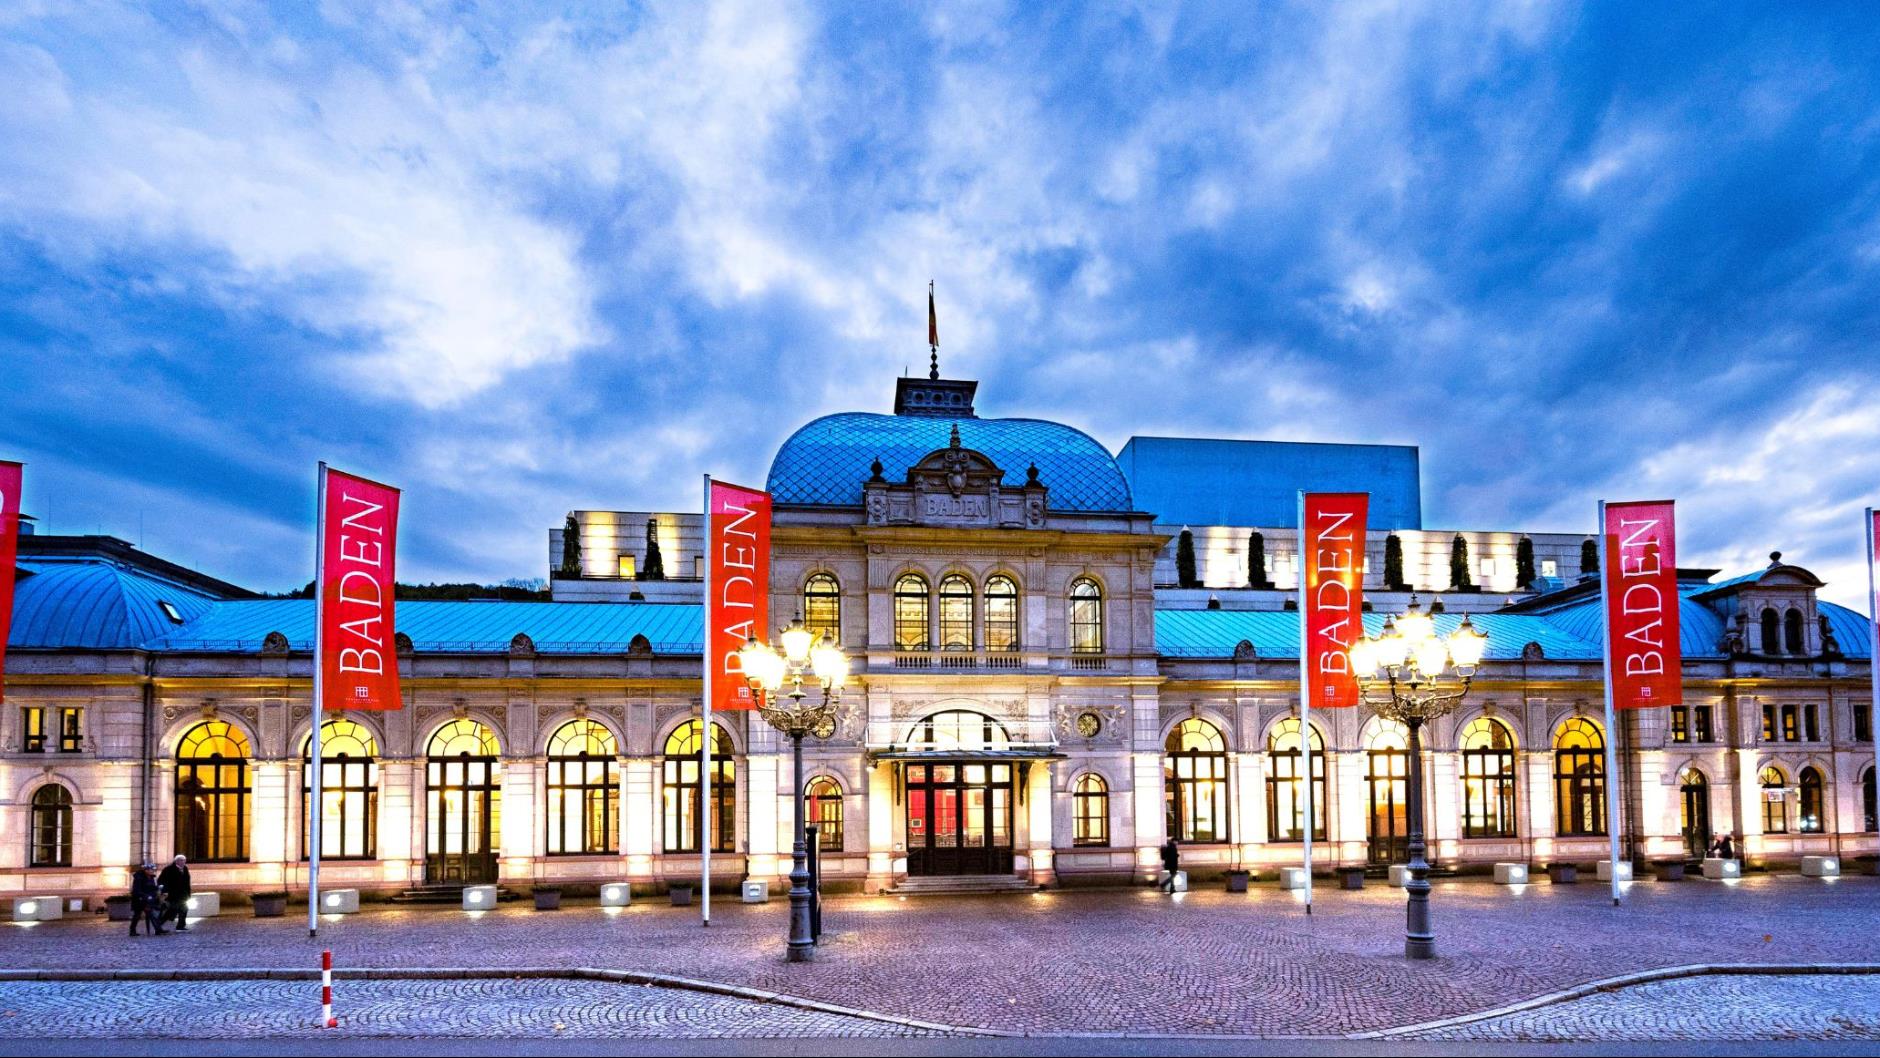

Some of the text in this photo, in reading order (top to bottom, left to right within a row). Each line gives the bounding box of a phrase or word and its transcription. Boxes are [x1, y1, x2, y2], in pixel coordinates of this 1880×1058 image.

[339, 491, 384, 676] BADEN
[925, 499, 989, 518] BADEN
[1318, 510, 1354, 676] BADEN
[1620, 518, 1664, 678] BADEN
